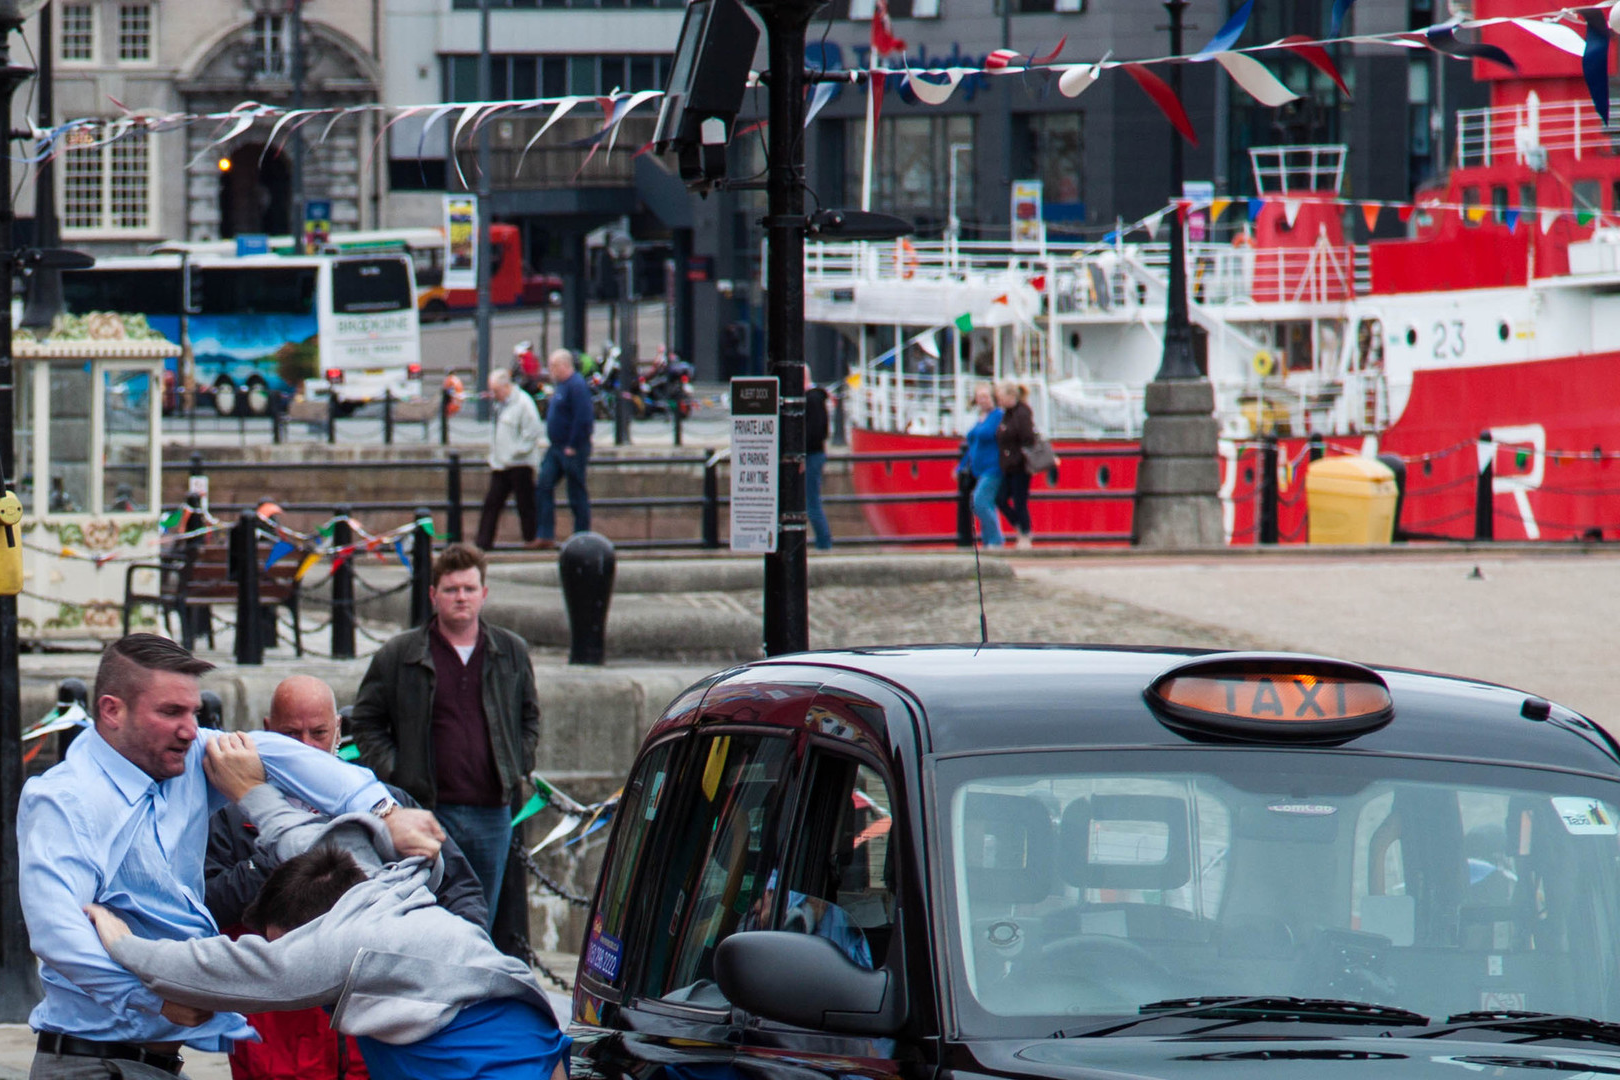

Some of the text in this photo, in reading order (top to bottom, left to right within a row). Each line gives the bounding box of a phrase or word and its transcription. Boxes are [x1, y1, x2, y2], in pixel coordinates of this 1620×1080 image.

[1432, 320, 1466, 358] 23
[735, 420, 774, 435] PRIVATE LAND
[747, 453, 769, 466] PARKING
[1216, 676, 1348, 718] TAXI
